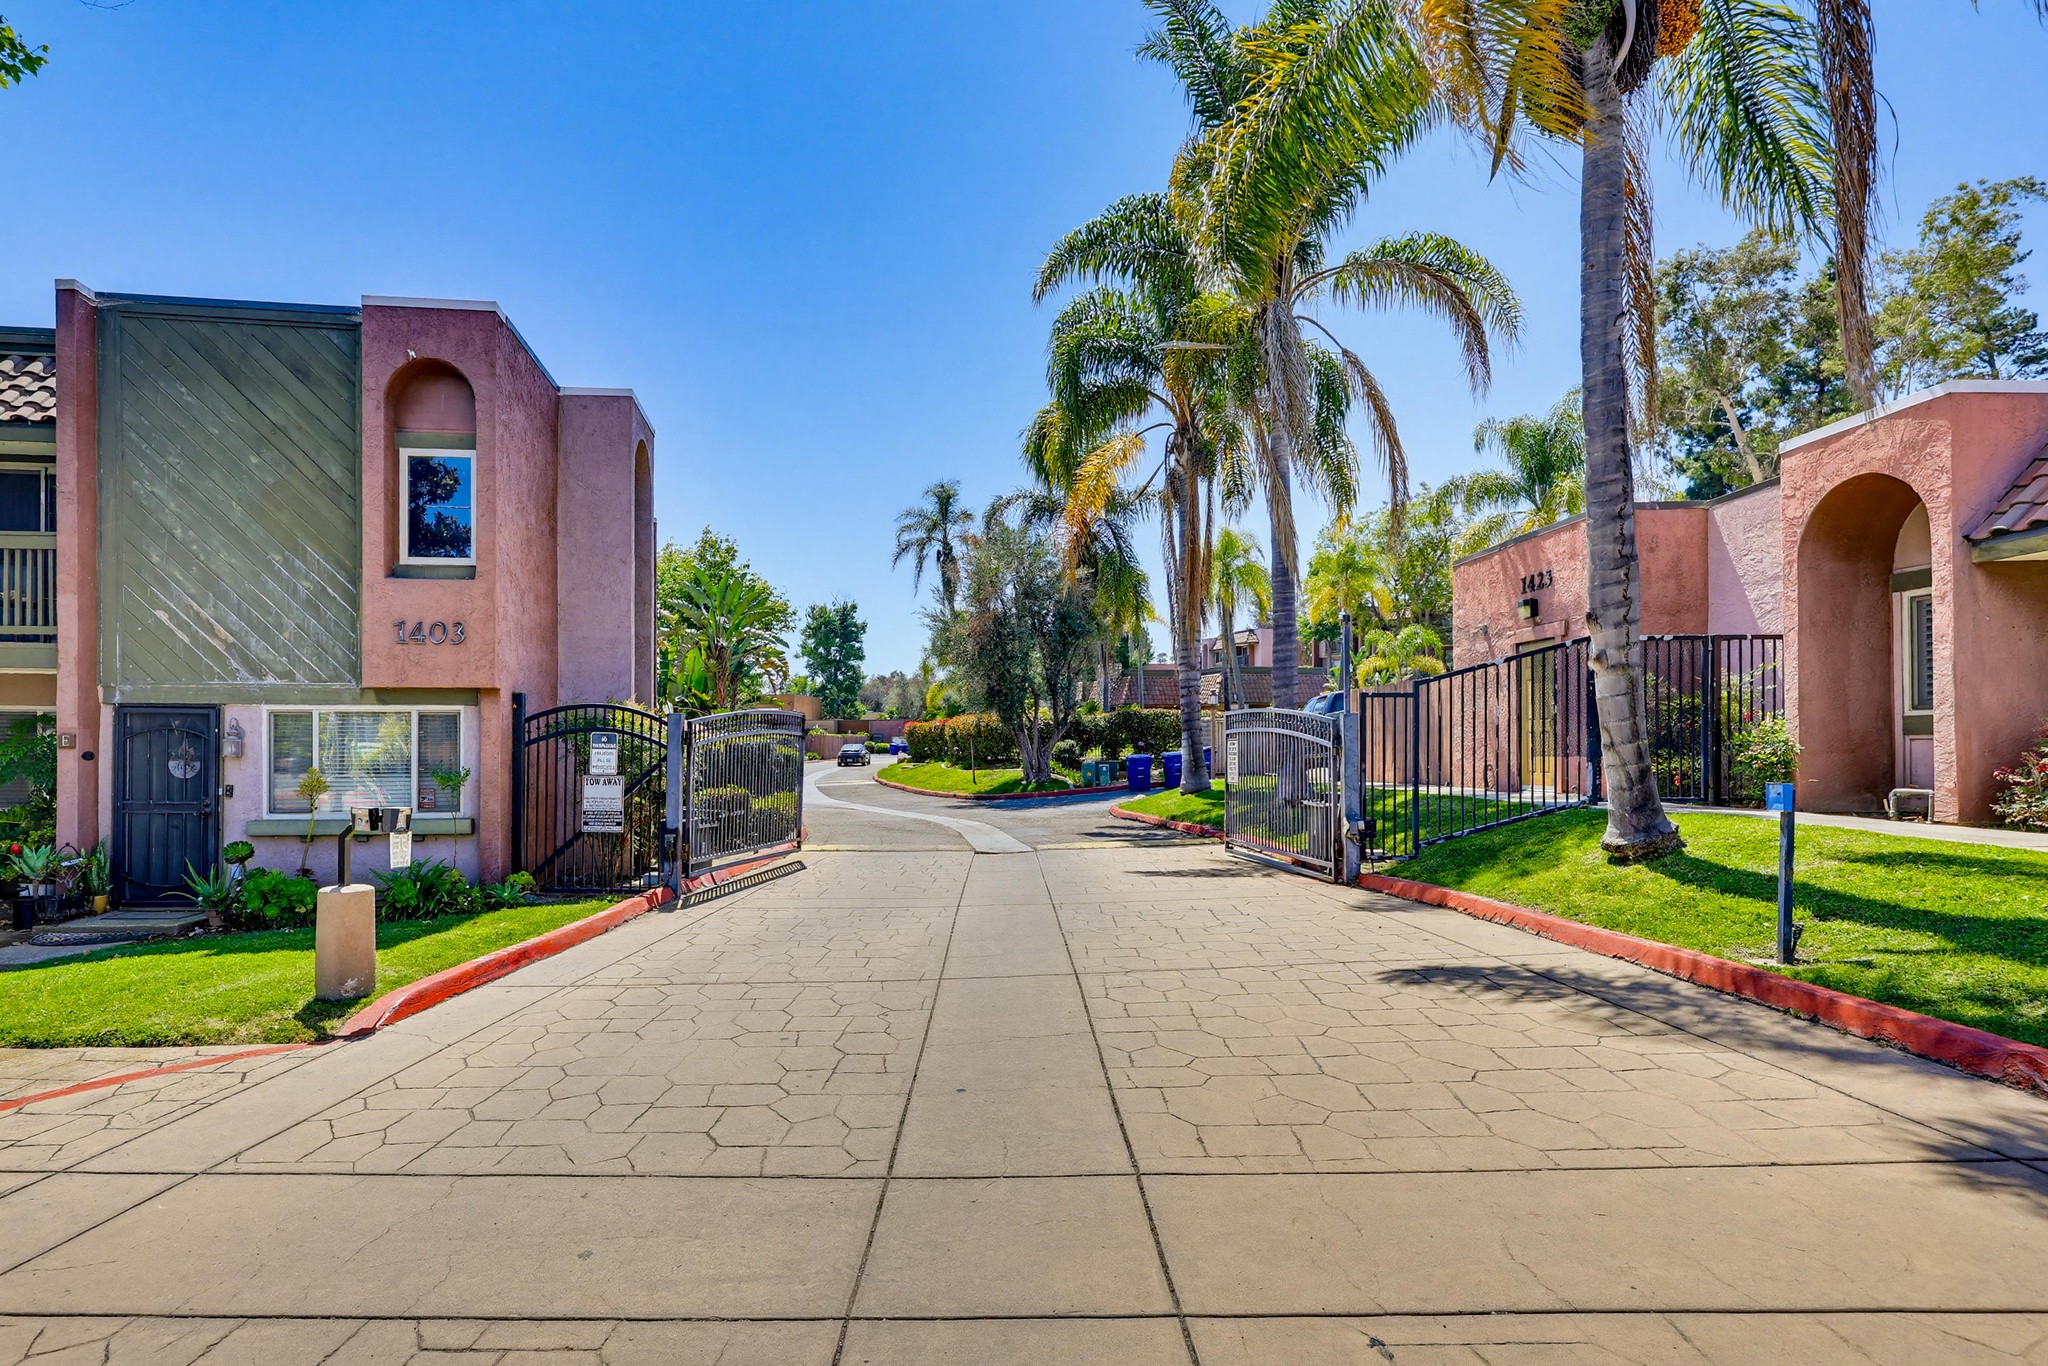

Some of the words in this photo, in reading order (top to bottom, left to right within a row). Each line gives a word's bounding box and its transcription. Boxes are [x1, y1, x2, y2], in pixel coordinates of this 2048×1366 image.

[1520, 569, 1553, 594] 1423
[393, 620, 466, 645] 1403
[62, 734, 70, 747] E
[585, 778, 600, 786] TOW
[602, 778, 622, 786] AWAY
